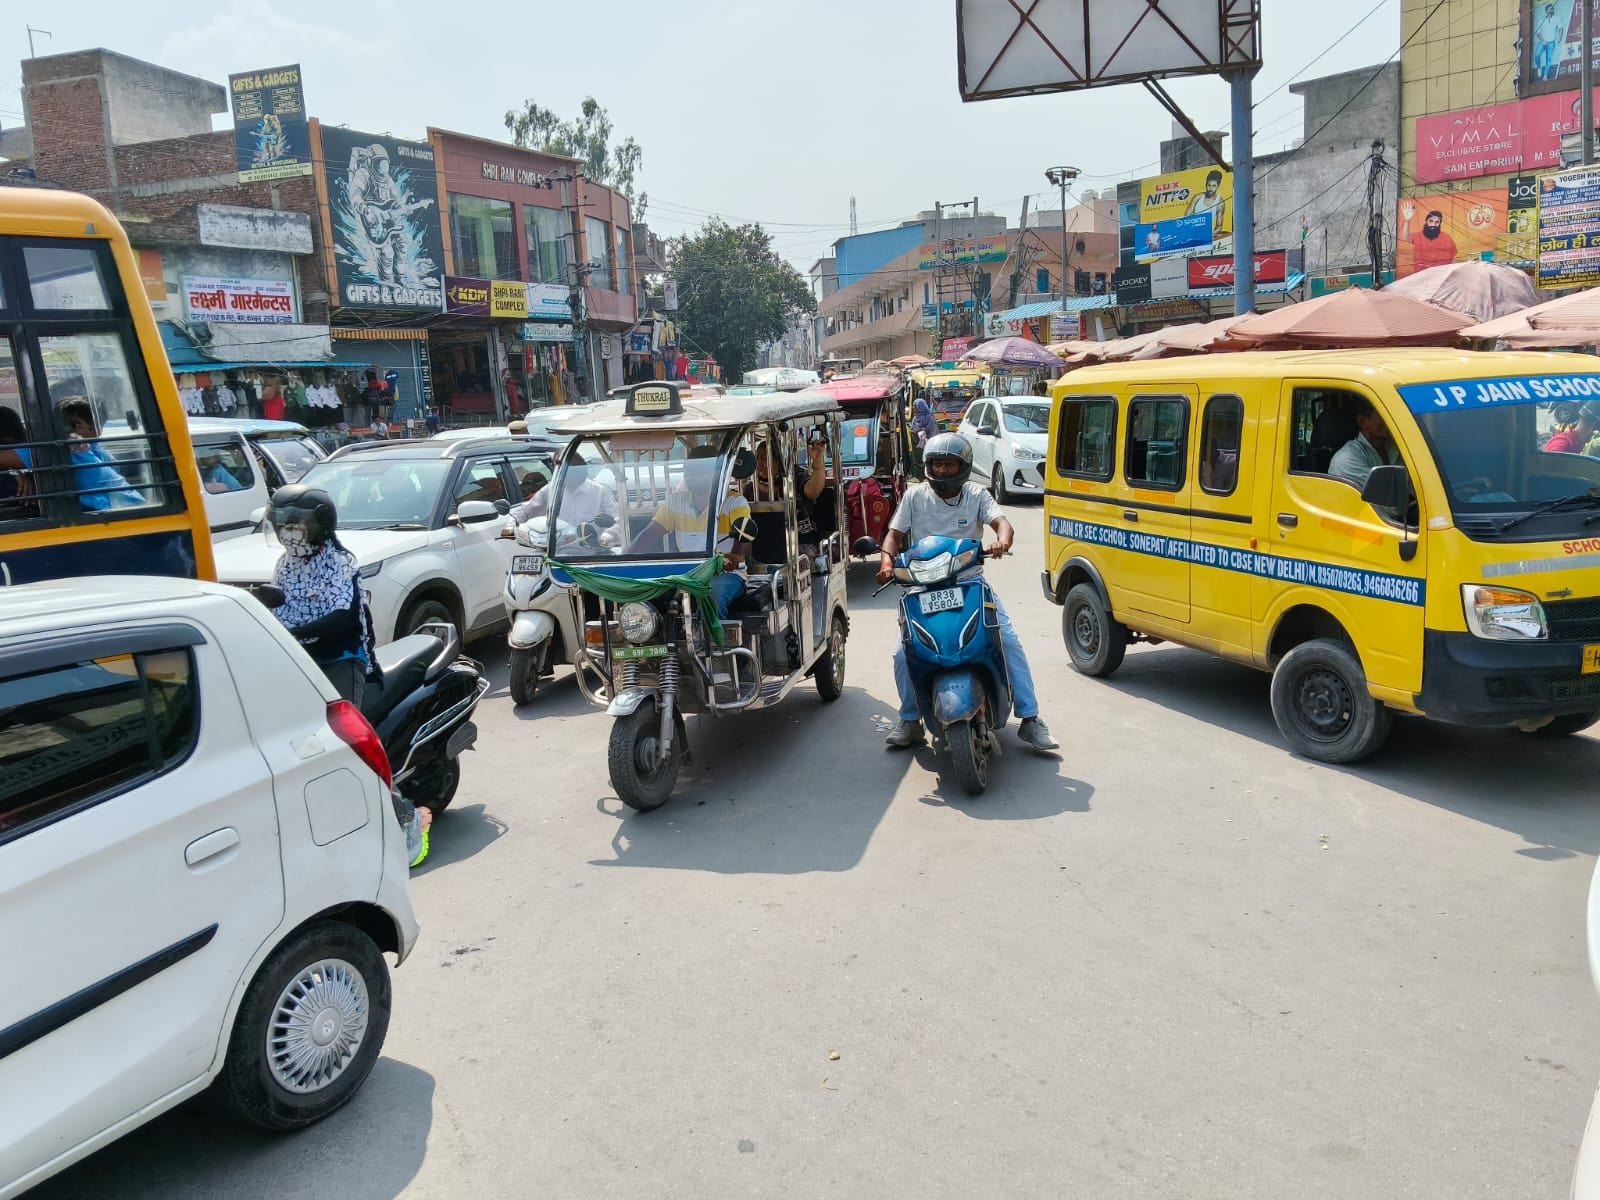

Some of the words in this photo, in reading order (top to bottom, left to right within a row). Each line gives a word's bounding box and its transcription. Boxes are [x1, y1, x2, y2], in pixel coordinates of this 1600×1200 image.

[232, 76, 254, 92] GIFTS
[255, 75, 263, 88] &
[263, 70, 298, 87] GADGETS
[1431, 124, 1520, 148] VIMAL
[398, 146, 410, 156] GIFTS
[414, 150, 434, 160] GADGETS
[1436, 146, 1481, 159] EXCLUSIVE
[1484, 141, 1512, 152] STORE
[482, 162, 498, 180] SHRI
[500, 166, 514, 182] RAM
[1444, 164, 1466, 174] SAIN
[1470, 155, 1522, 170] EMPORIUM
[1560, 173, 1585, 182] YOGESH
[1156, 182, 1179, 192] LUX
[1146, 188, 1190, 206] NITRO
[1540, 238, 1568, 251] लोन
[1572, 234, 1588, 248] ही
[1118, 277, 1148, 286] JOCKEY
[190, 290, 226, 310] लक्ष्मी
[346, 284, 380, 302] GIFTS
[381, 286, 394, 304] &
[394, 287, 442, 307] GADGETS
[458, 287, 488, 301] KDM
[494, 287, 508, 298] SHRI
[496, 300, 525, 312] COMPLEX
[1173, 306, 1200, 315] STORE
[636, 392, 668, 402] THUKRAL
[1434, 388, 1448, 406] J
[1449, 386, 1466, 404] P
[1477, 382, 1531, 402] JAIN
[1059, 520, 1074, 536] JAIN
[1074, 523, 1083, 538] SR
[1084, 525, 1098, 541] SEC
[1099, 528, 1127, 548] SCHOOL
[1130, 534, 1165, 555] SONEPAT
[1218, 549, 1228, 567] TO
[1230, 552, 1252, 571] CBSE
[1254, 556, 1277, 576] NEW
[930, 590, 954, 601] BR38
